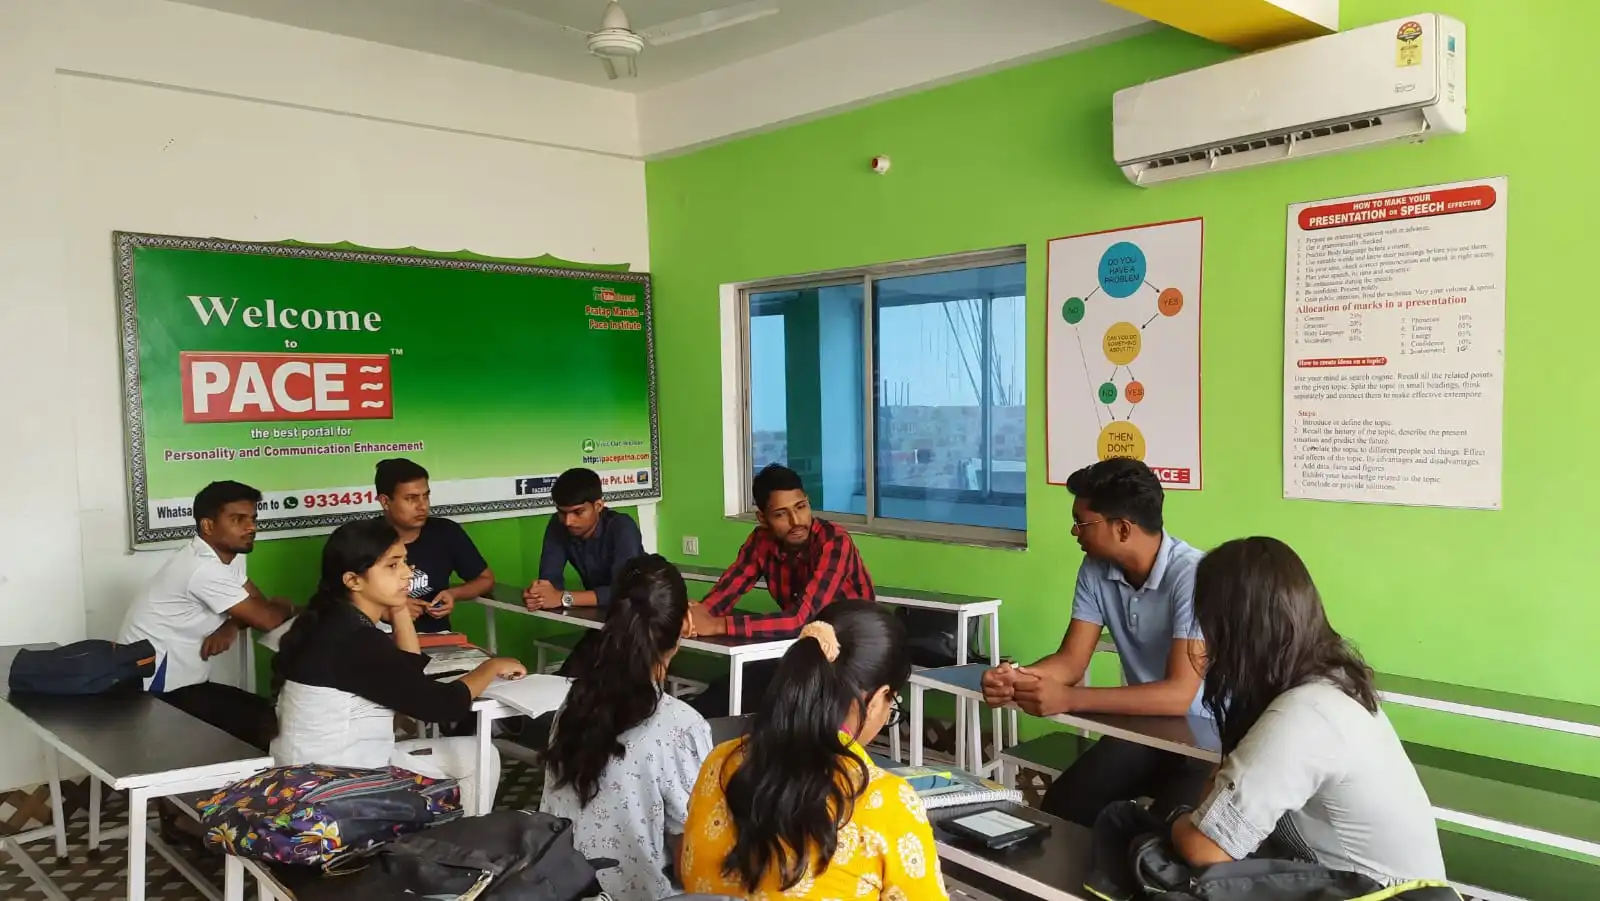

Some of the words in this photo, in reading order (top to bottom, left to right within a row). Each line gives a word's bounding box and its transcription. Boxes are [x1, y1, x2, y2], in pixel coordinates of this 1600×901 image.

[1353, 201, 1370, 210] HOW
[1384, 196, 1406, 206] MAKE
[1409, 194, 1430, 202] YOUR
[1309, 209, 1386, 226] PRESENTATION
[1400, 201, 1444, 216] SPEECH
[1448, 199, 1481, 209] EFFECTIVE
[1108, 258, 1118, 266] DO
[1120, 257, 1137, 265] YOU
[1105, 274, 1140, 284] PROBLEM
[1296, 304, 1339, 313] Allocation
[1342, 303, 1352, 311] of
[1354, 301, 1382, 309] marks
[1385, 300, 1394, 308] in
[1406, 296, 1467, 309] presentation
[187, 295, 382, 332] Welcome
[610, 320, 642, 330] Institute
[284, 339, 298, 349] to
[390, 348, 404, 356] TM
[1471, 372, 1493, 380] points
[192, 361, 350, 414] PACE
[1351, 383, 1366, 391] Split
[1368, 381, 1377, 389] the
[1379, 382, 1396, 390] topic
[250, 428, 270, 440] the
[273, 427, 298, 438] best
[301, 426, 334, 439] portal
[336, 426, 352, 436] for
[1109, 433, 1133, 441] THEN
[1334, 436, 1355, 444] predict
[164, 448, 235, 462] Personality
[239, 446, 260, 458] and
[264, 442, 351, 457] Communication
[353, 440, 424, 453] Enhancement
[1107, 444, 1135, 452] DON'T
[1368, 446, 1396, 454] different
[1464, 448, 1485, 456] Effect
[610, 475, 622, 485] Pvt.
[624, 474, 635, 484] Ltd.
[1152, 469, 1180, 481] ACE
[1342, 473, 1376, 481] knowledge
[270, 500, 280, 510] to
